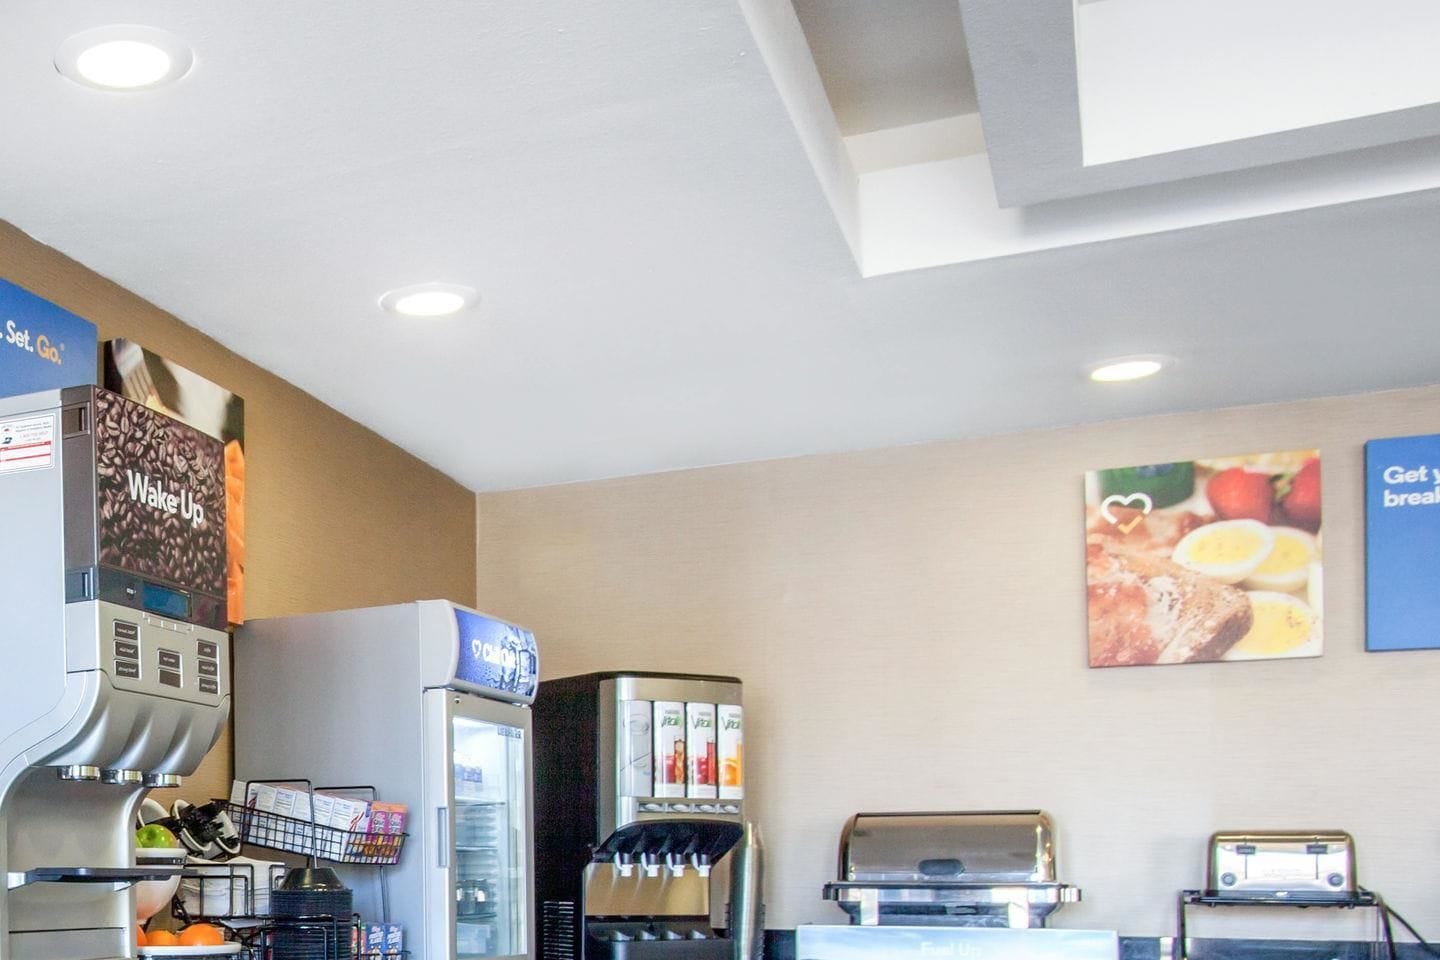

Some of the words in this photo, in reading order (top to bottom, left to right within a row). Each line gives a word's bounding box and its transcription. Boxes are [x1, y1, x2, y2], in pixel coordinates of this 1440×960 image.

[6, 320, 34, 353] Set.
[1383, 465, 1429, 484] Get
[127, 469, 178, 514] Wake
[180, 489, 204, 528] Up
